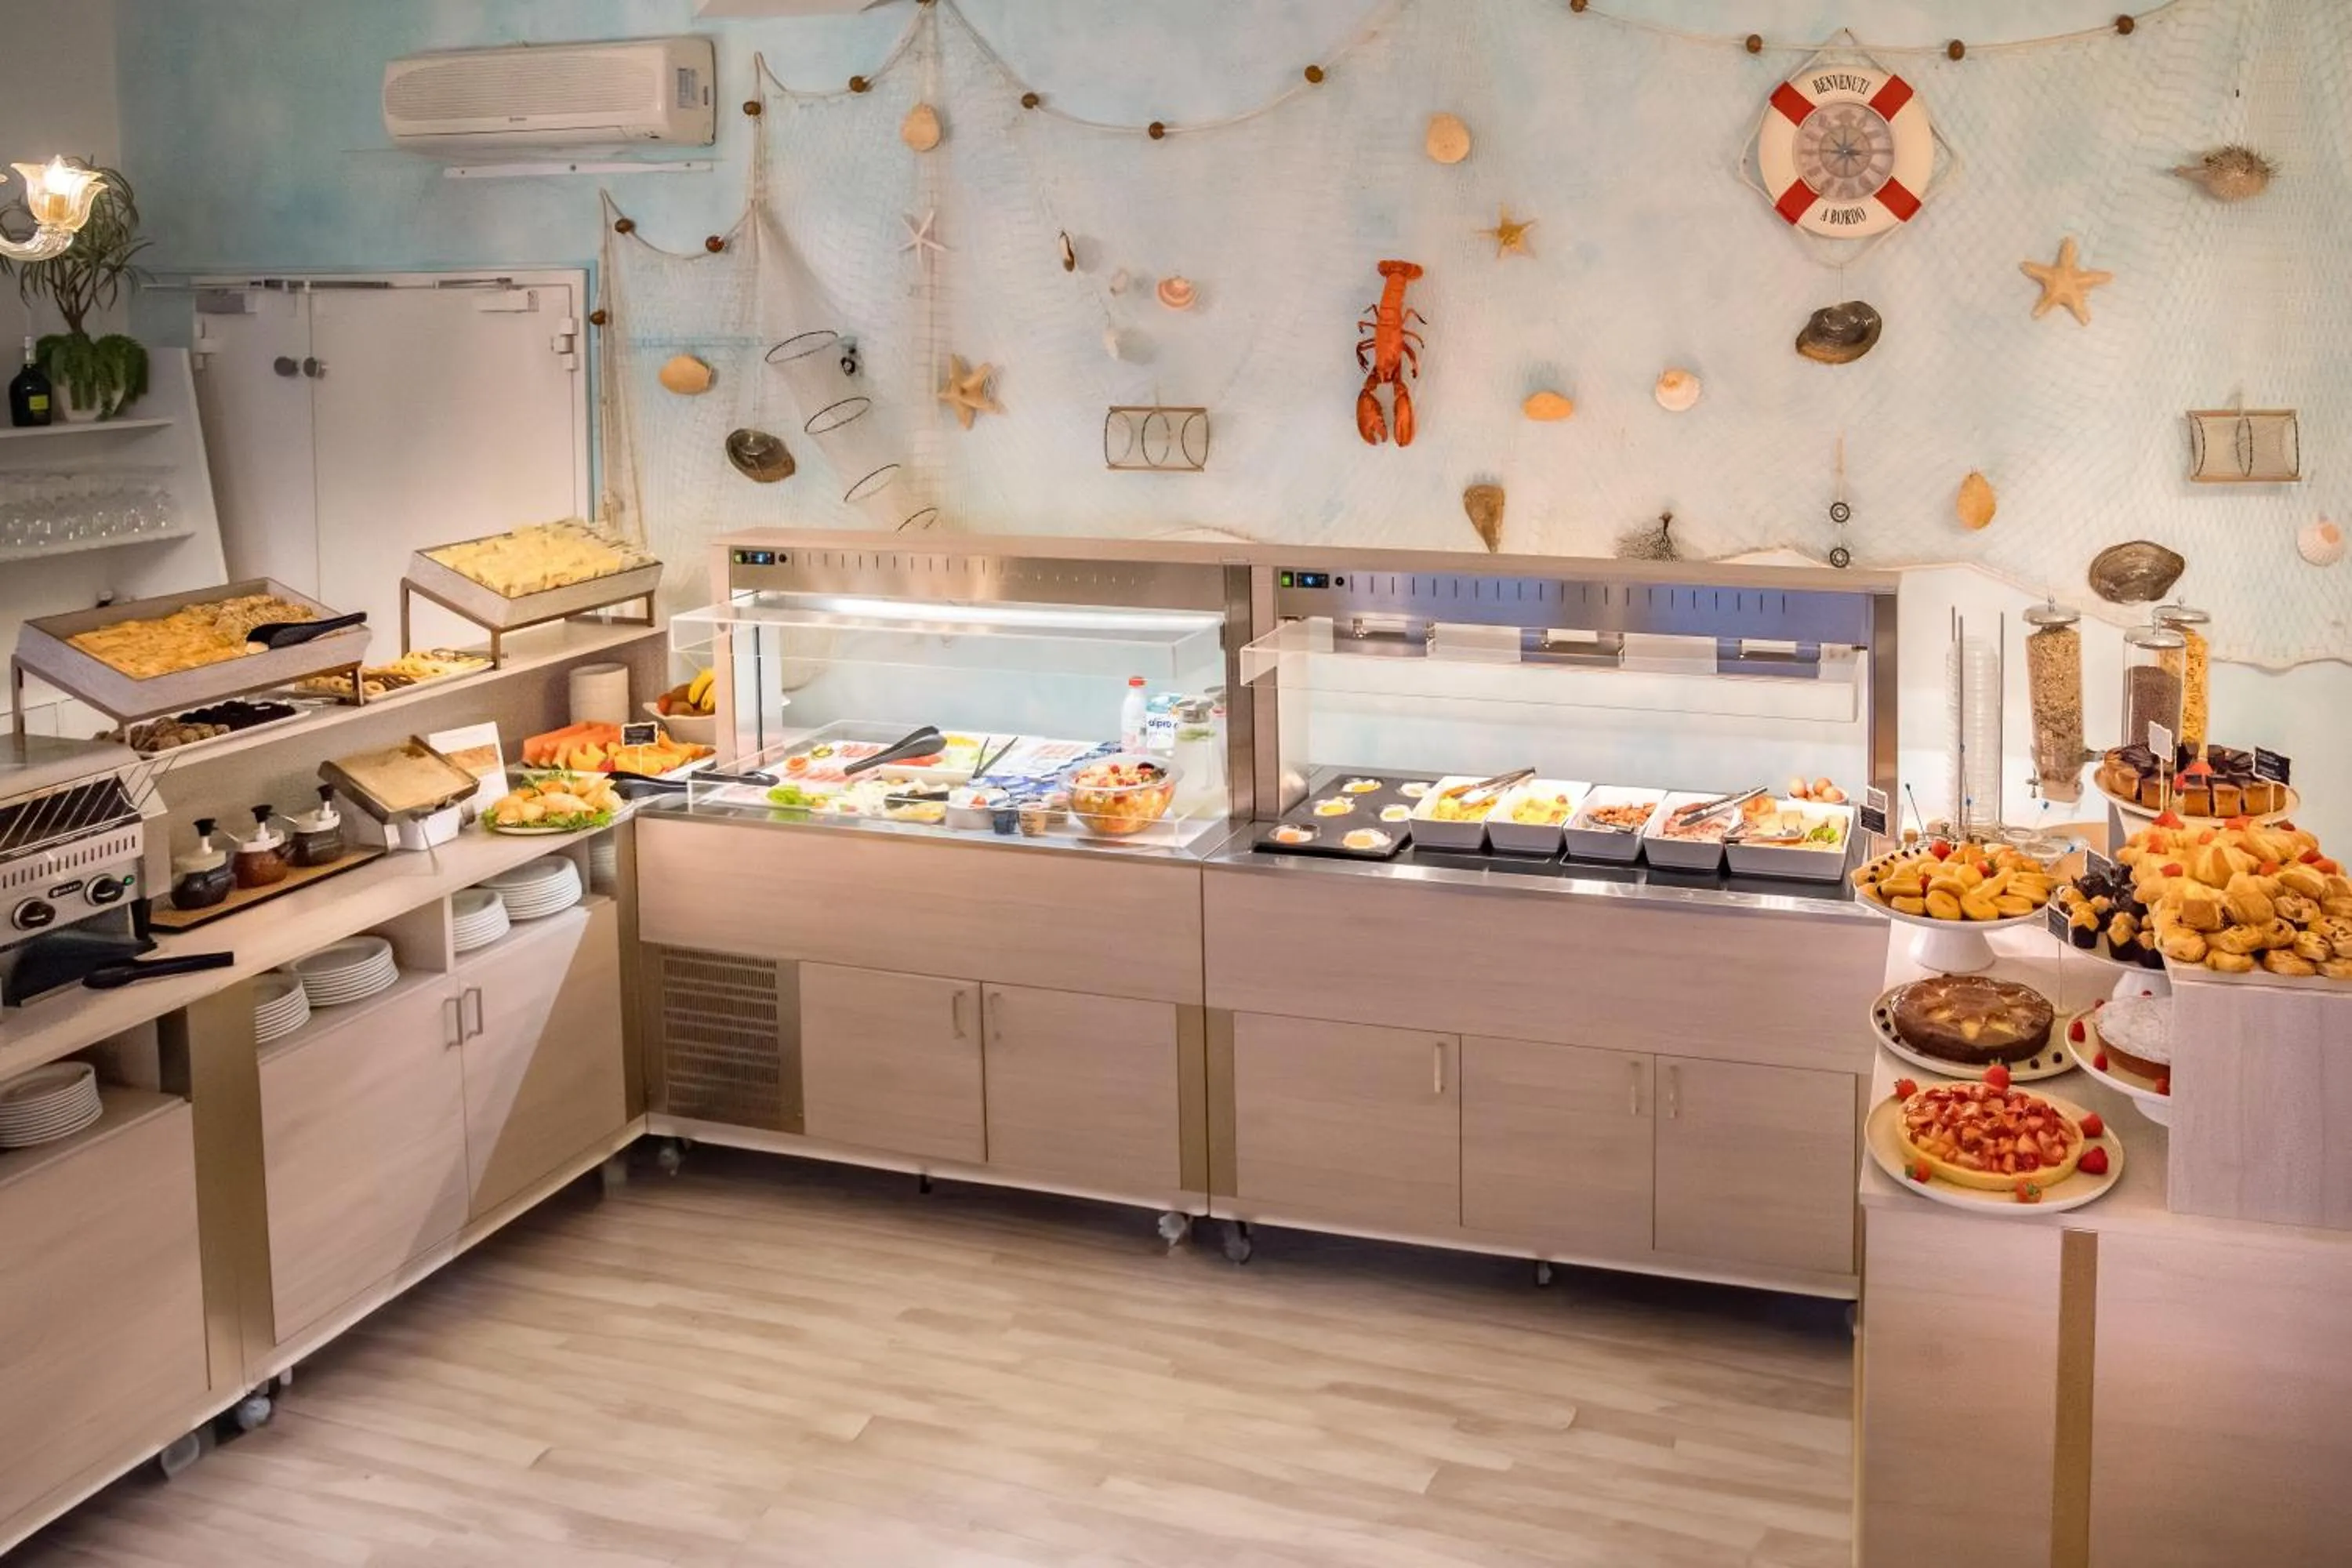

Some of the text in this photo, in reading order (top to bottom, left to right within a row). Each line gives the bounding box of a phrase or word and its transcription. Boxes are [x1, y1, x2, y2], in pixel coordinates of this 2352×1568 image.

[1812, 74, 1872, 95] BENVENUTI
[1820, 208, 1867, 225] A BORDO
[1148, 717, 1172, 729] alpro
